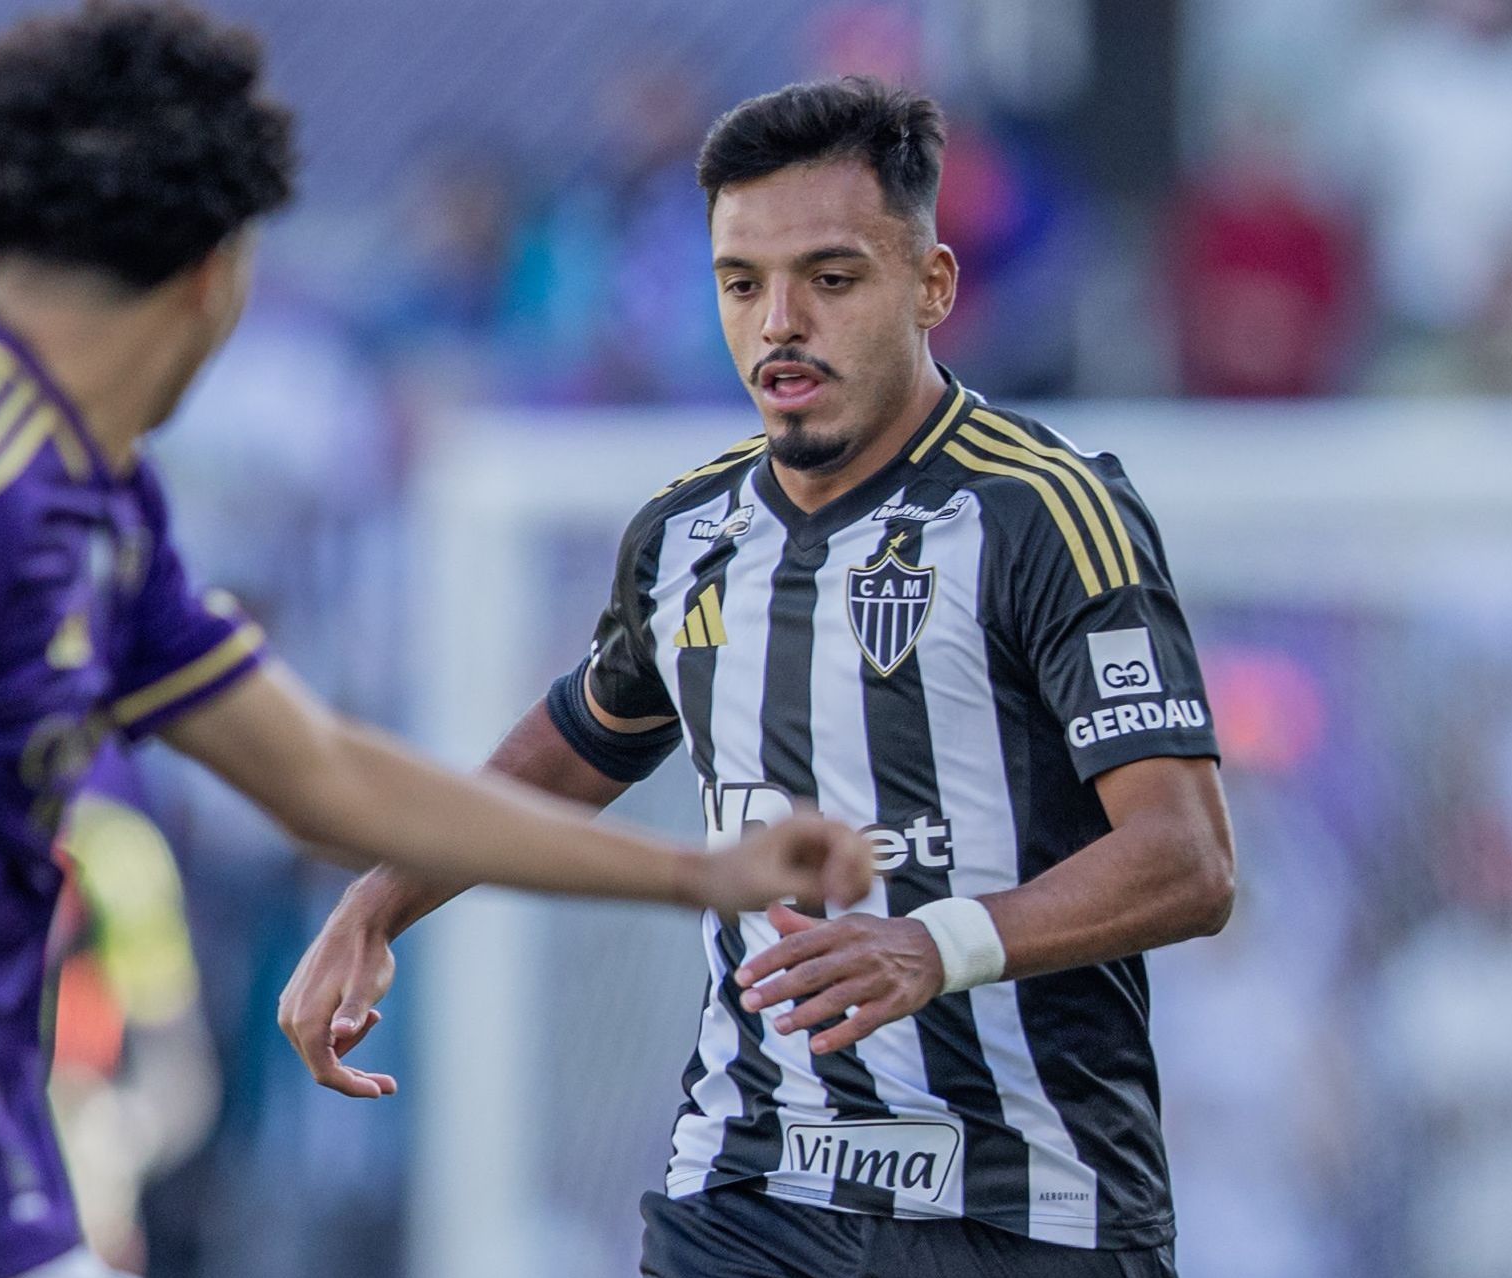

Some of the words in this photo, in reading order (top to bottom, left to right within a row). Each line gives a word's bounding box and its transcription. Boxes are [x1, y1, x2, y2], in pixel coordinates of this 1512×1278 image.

[859, 579, 922, 598] CAM
[1068, 699, 1206, 748] GERDAU
[795, 1133, 938, 1190] Vilma
